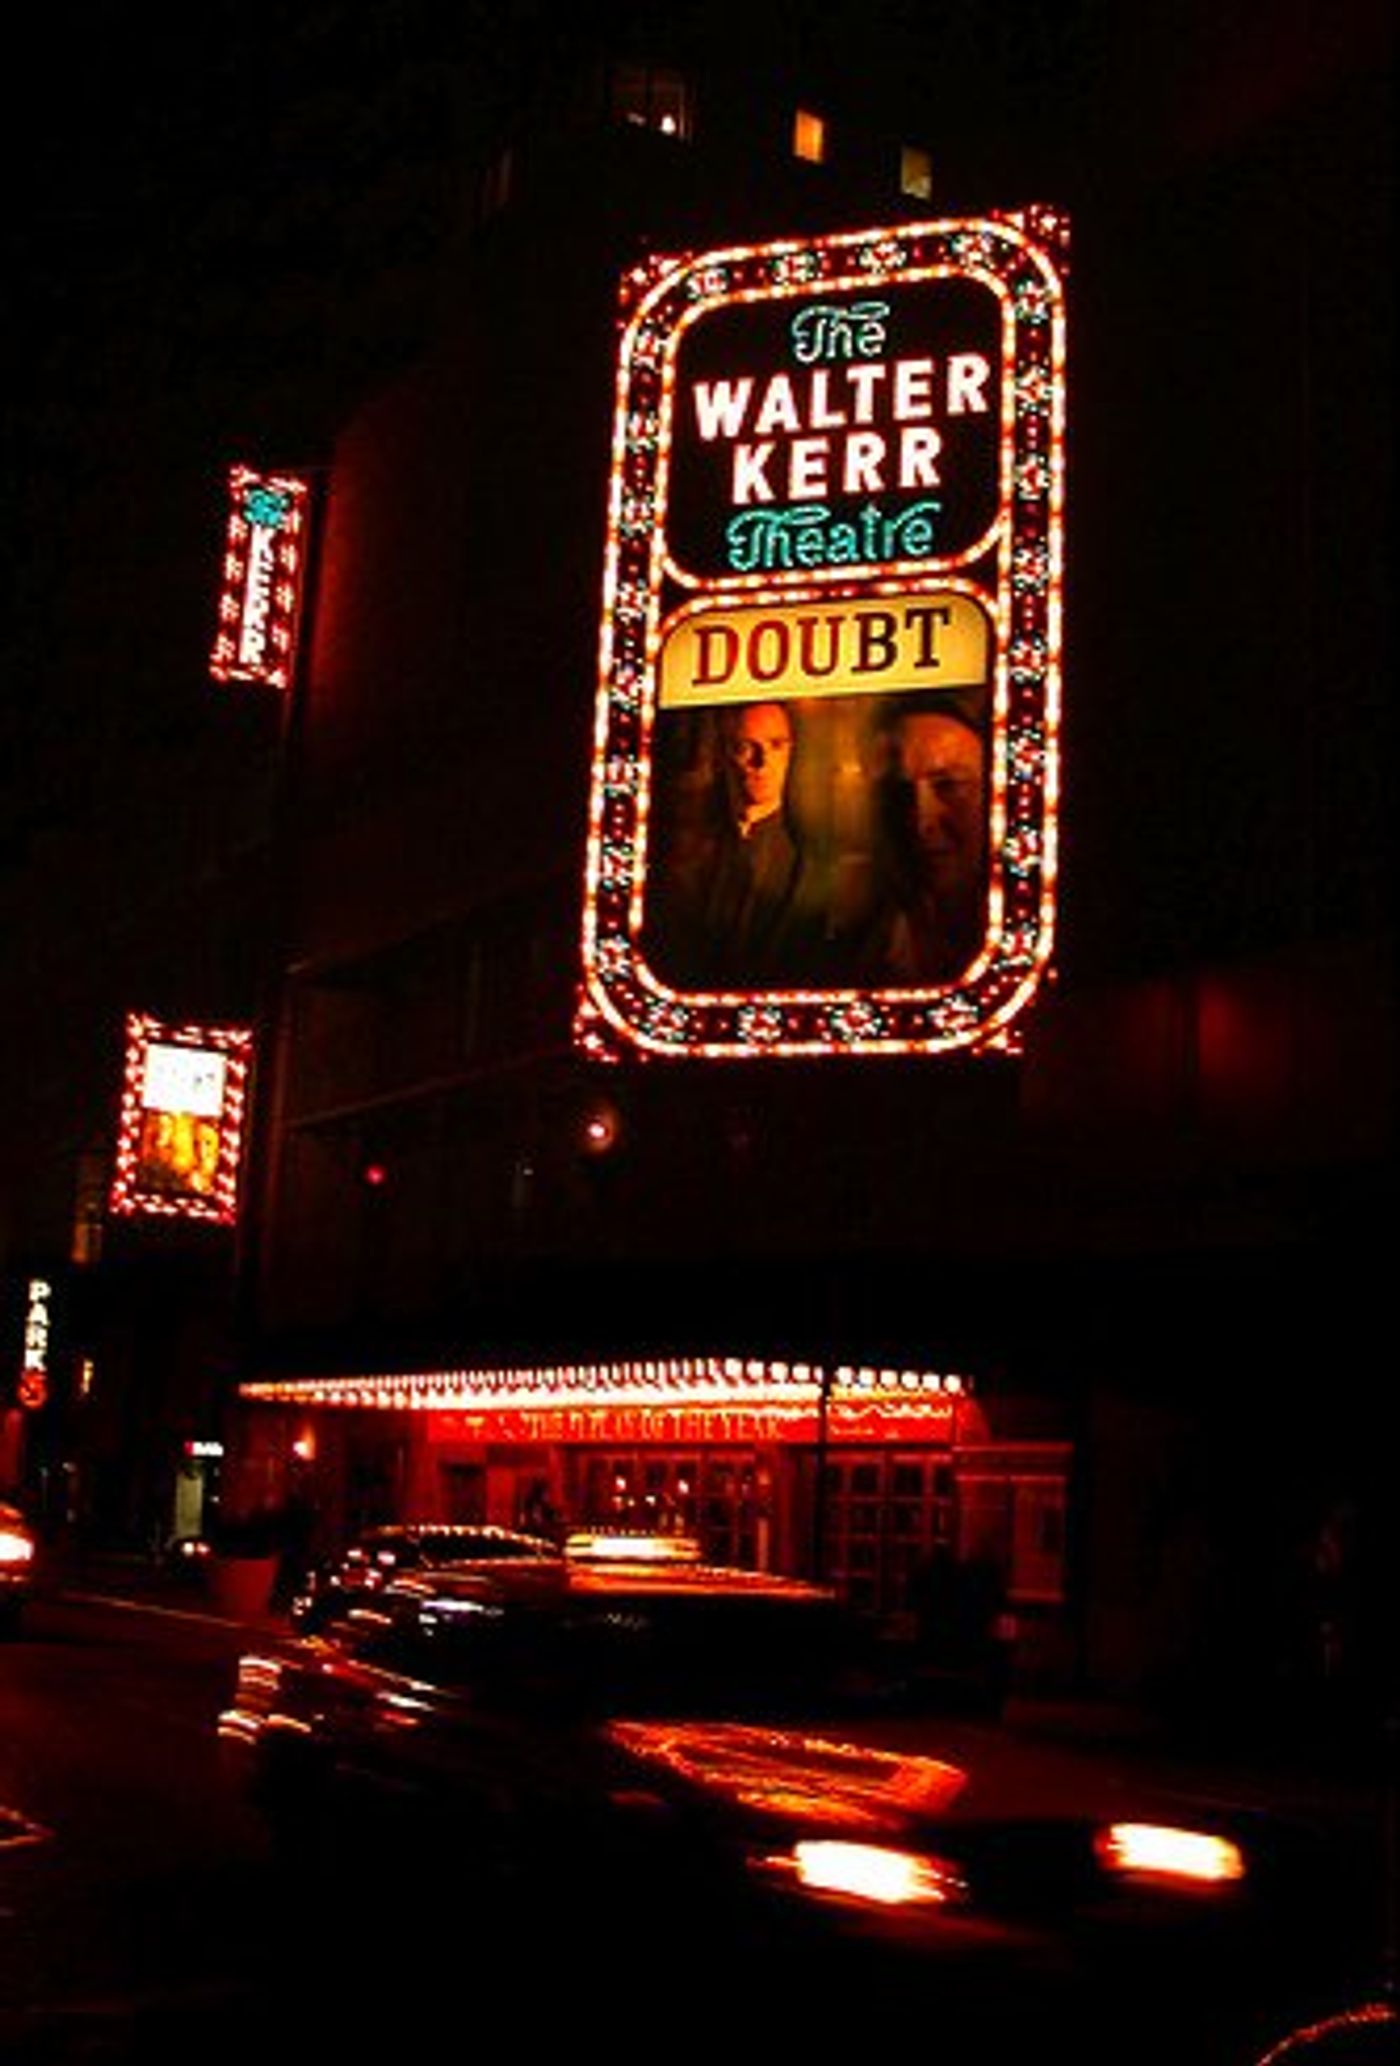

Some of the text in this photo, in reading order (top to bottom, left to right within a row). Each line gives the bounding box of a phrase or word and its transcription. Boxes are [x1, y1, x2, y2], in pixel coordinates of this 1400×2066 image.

[791, 301, 889, 362] The
[693, 353, 990, 440] WALTER
[732, 427, 942, 503] KERR
[726, 503, 942, 570] Theatre
[691, 608, 950, 687] DOUBT
[25, 1279, 51, 1371] PARK
